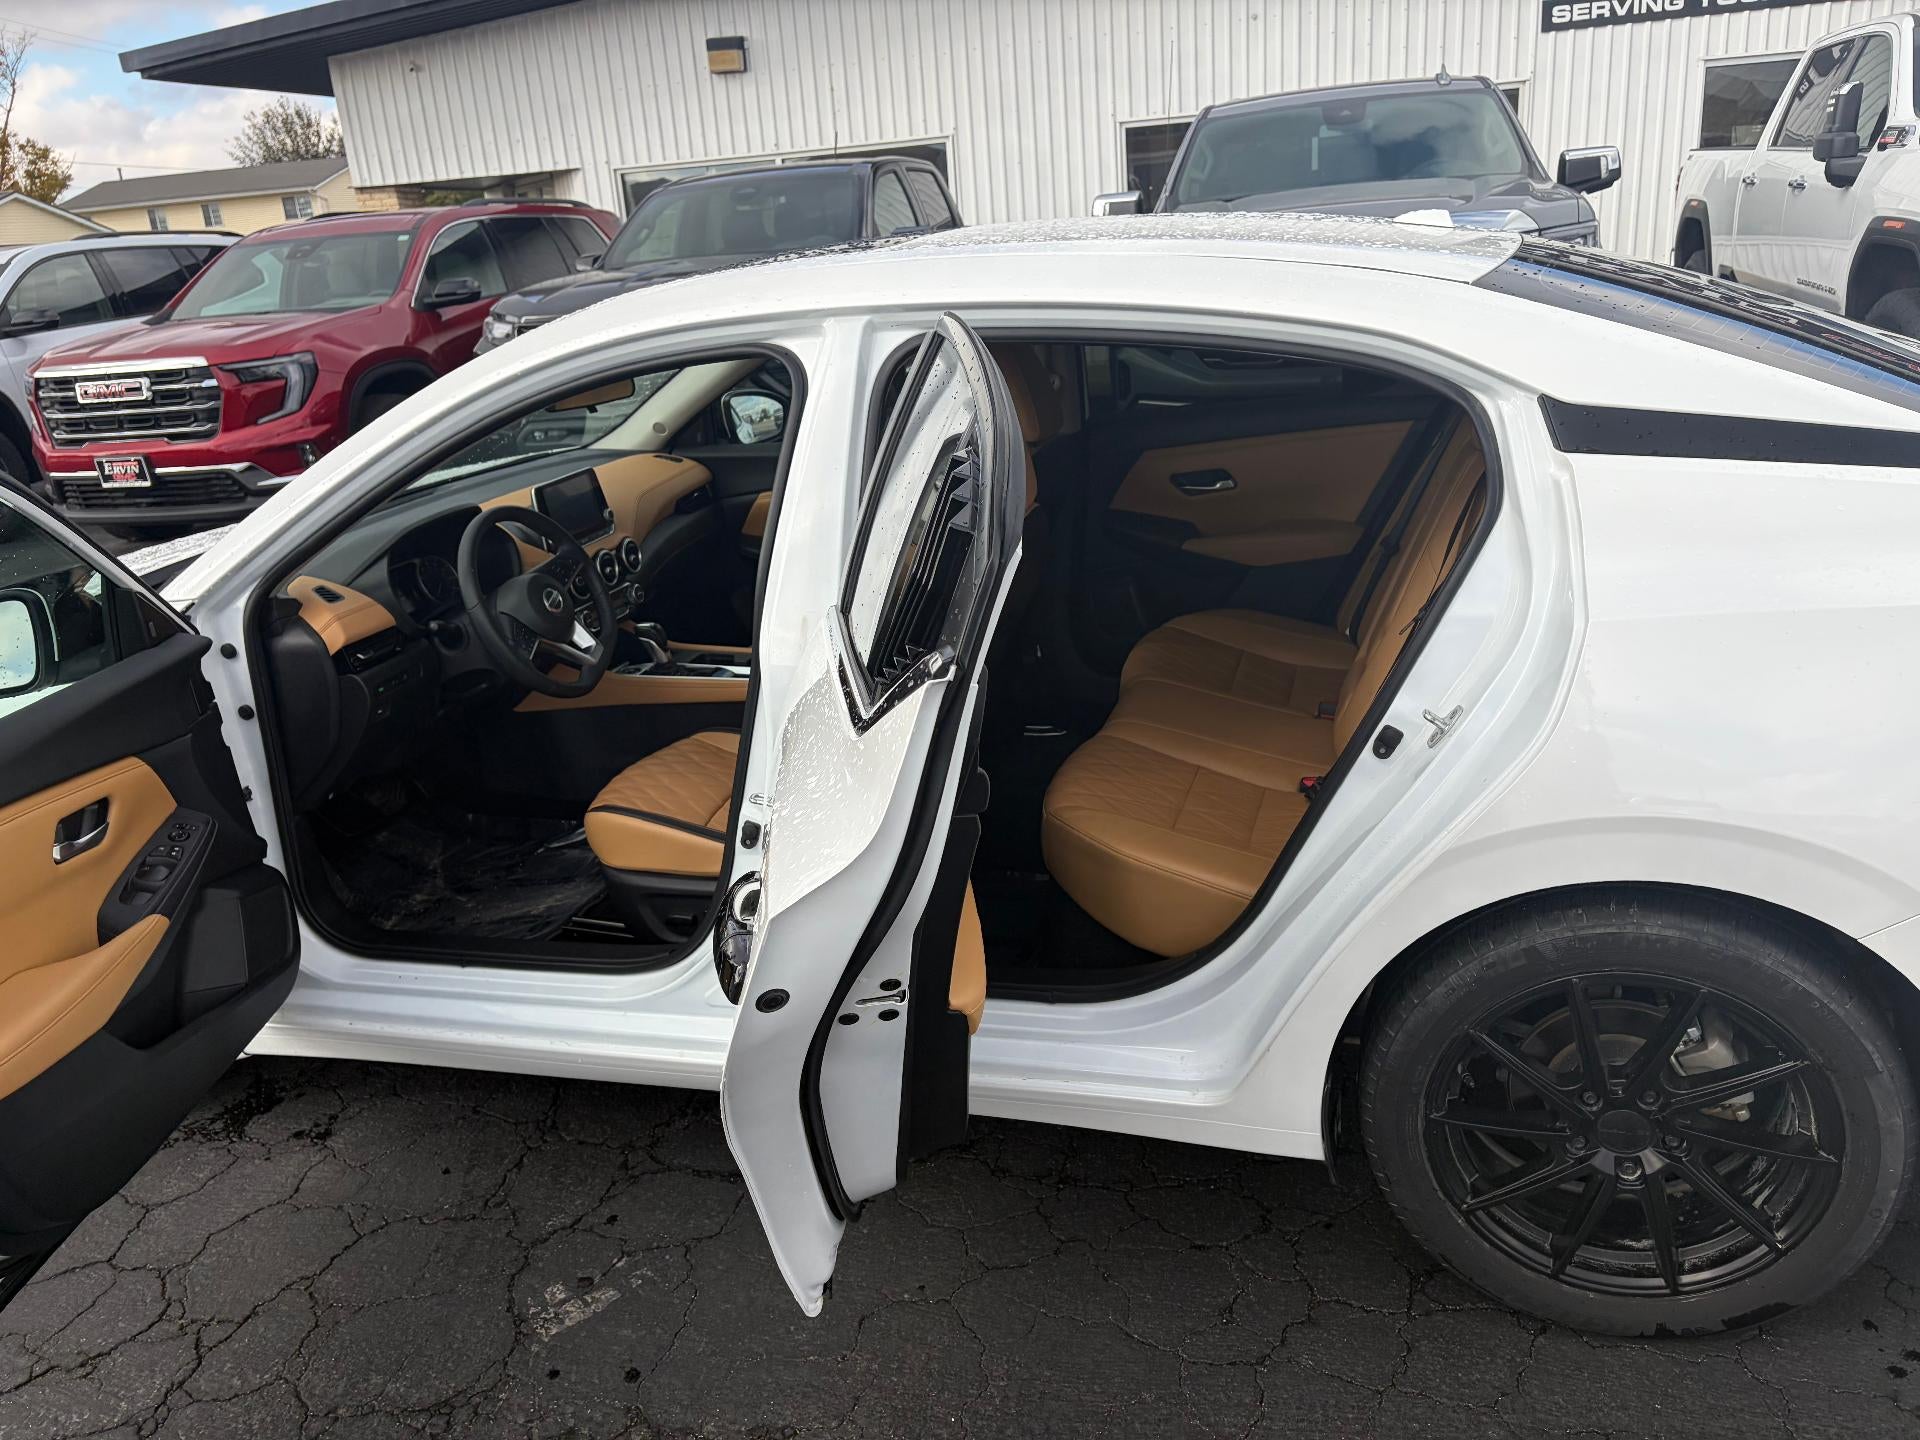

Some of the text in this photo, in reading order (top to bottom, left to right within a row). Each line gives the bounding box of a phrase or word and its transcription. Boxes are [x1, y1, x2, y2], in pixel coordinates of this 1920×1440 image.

[1551, 0, 1685, 23] SERVING
[79, 382, 142, 400] GMC
[103, 462, 140, 475] ERVIN
